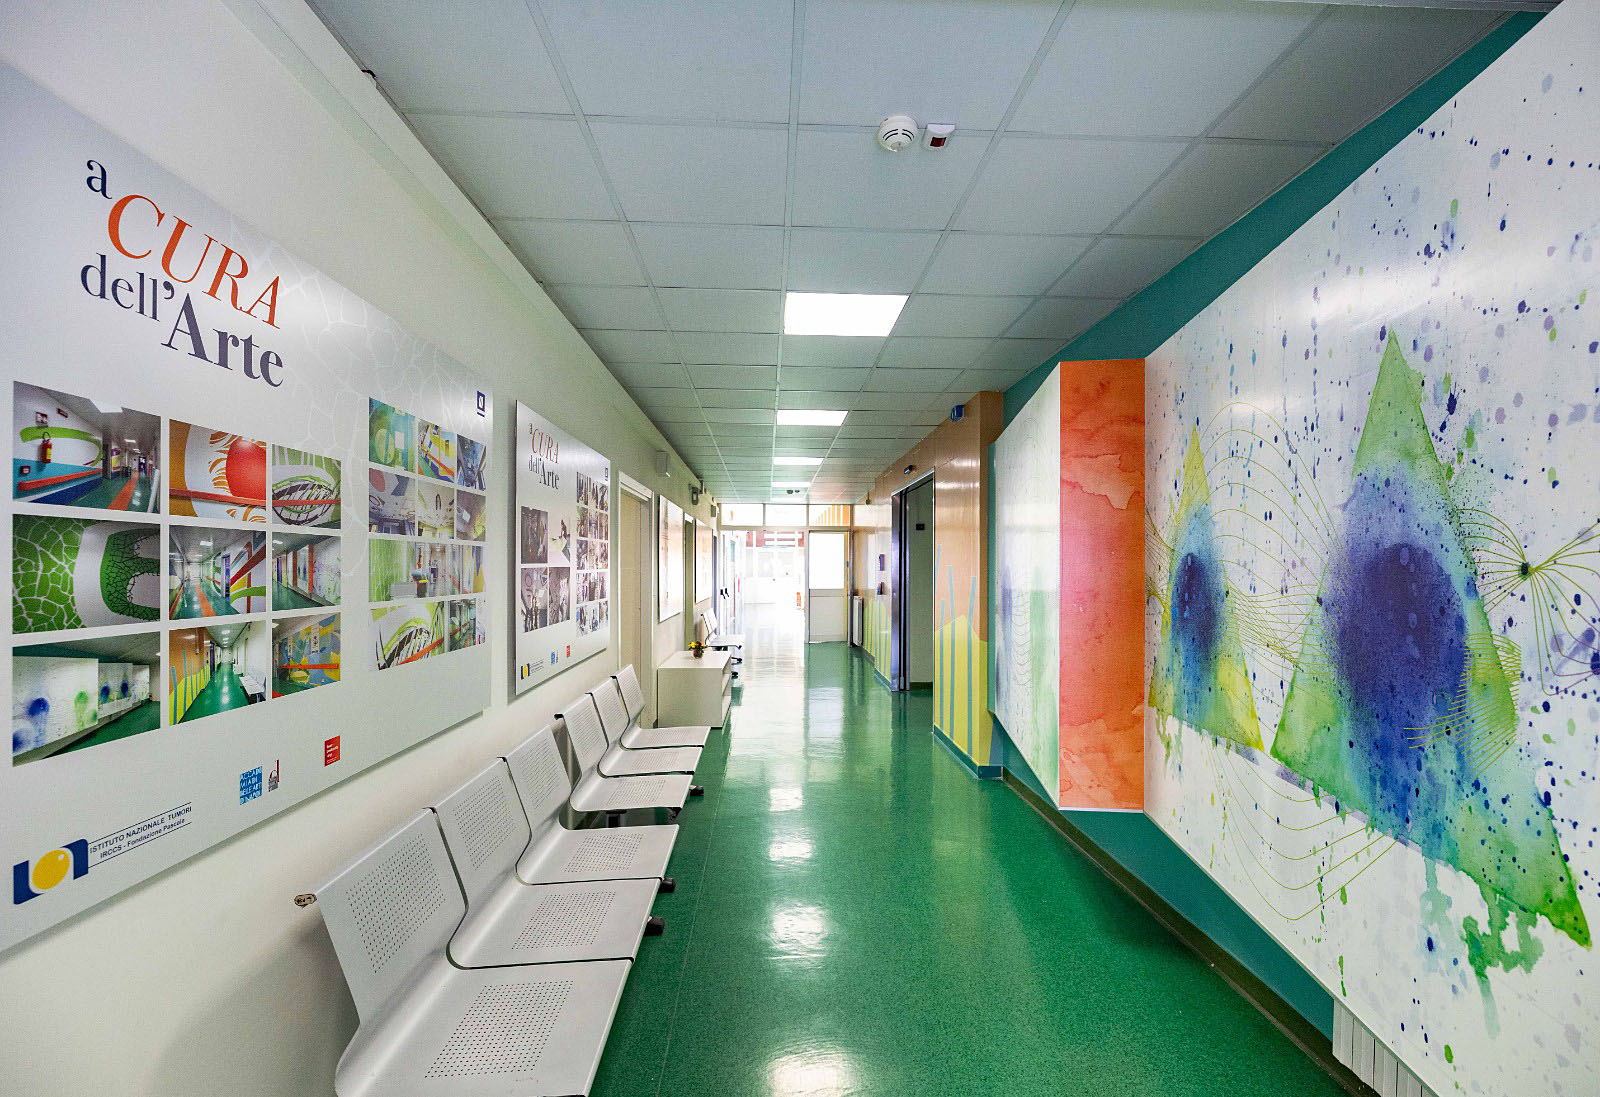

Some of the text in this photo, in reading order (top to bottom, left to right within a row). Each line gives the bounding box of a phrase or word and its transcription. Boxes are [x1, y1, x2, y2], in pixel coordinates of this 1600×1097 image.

[86, 159, 281, 330] a CURA
[80, 252, 284, 388] dell'Arte
[531, 428, 559, 465] CURA
[89, 806, 192, 854] ISTITUTO NAZIONALE TUMORI
[100, 845, 122, 859] IRCCS
[127, 828, 162, 847] Fondazione
